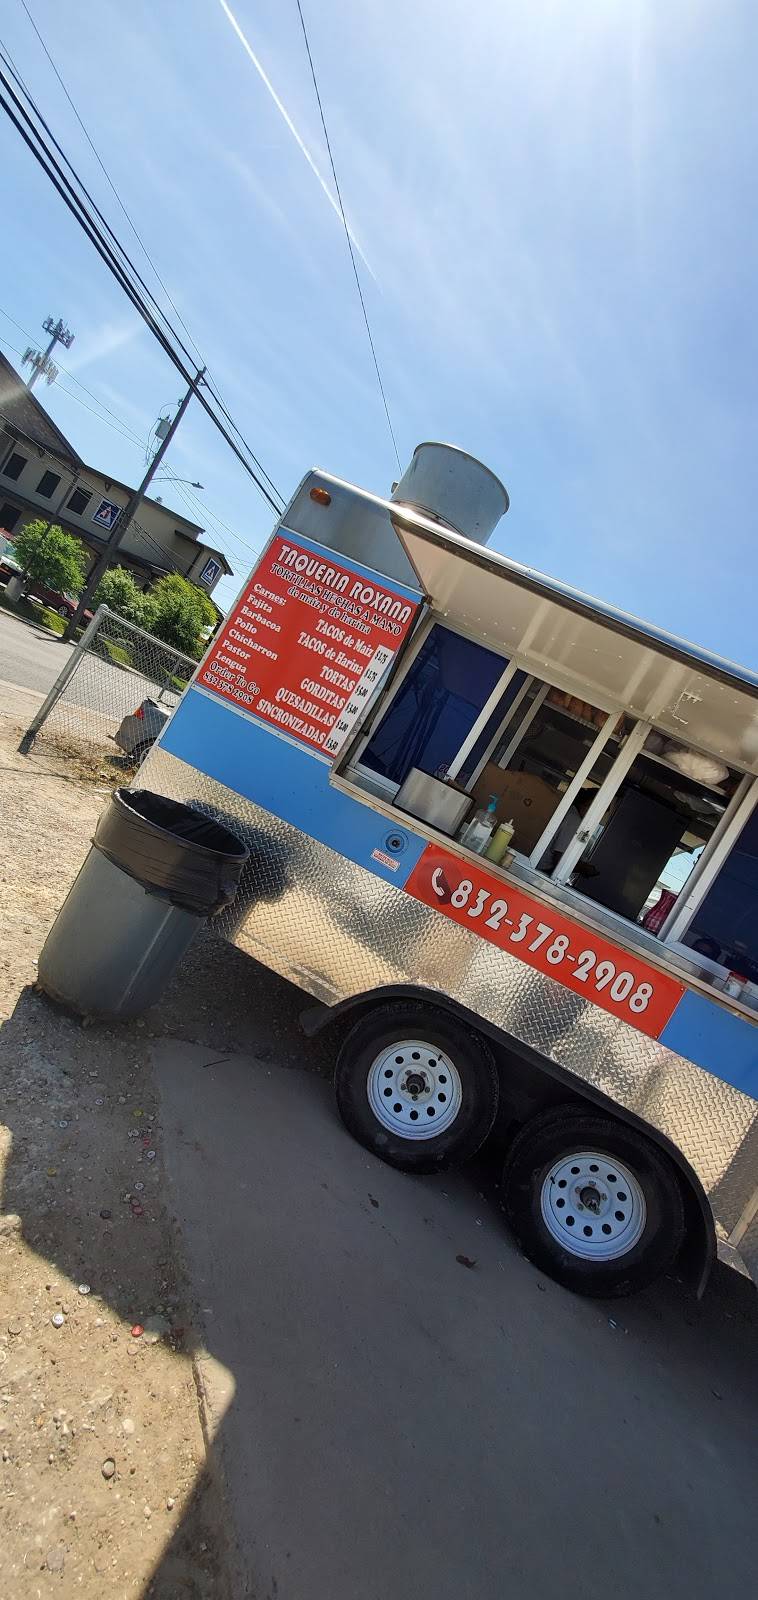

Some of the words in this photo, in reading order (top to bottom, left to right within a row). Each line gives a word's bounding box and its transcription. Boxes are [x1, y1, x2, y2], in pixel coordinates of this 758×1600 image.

[253, 583, 286, 606] Carnes:
[270, 563, 322, 596] TORTILLAS
[321, 588, 362, 616] HECHAS
[361, 608, 370, 620] A
[370, 614, 402, 636] MANO
[277, 545, 350, 592] TAQUERIA
[349, 582, 412, 624] ROXANA
[240, 606, 282, 632] Barbacoa
[246, 594, 273, 613] Fajita
[287, 586, 298, 598] de
[320, 604, 328, 614] y
[328, 606, 340, 618] de
[340, 612, 372, 634] harina
[234, 617, 258, 634] Pollo
[315, 619, 345, 642] TACOS
[343, 634, 354, 646] de
[222, 640, 251, 660] Pastor
[228, 628, 278, 660] Chicharron
[297, 632, 326, 654] TACOS
[325, 647, 336, 660] de
[334, 652, 364, 675] Harina
[210, 661, 236, 682] Order
[236, 674, 246, 688] To
[246, 680, 260, 695] Go
[215, 651, 247, 674] Lengua
[203, 671, 218, 684] 832
[218, 681, 234, 694] 378
[234, 688, 254, 704] 2908
[300, 678, 346, 710] GORDITAS
[320, 666, 356, 692] TORTAS
[256, 698, 327, 744] SINCRONIZADAS
[275, 688, 337, 726] QUESADILLAS
[450, 878, 654, 1014] 832-378-2908
